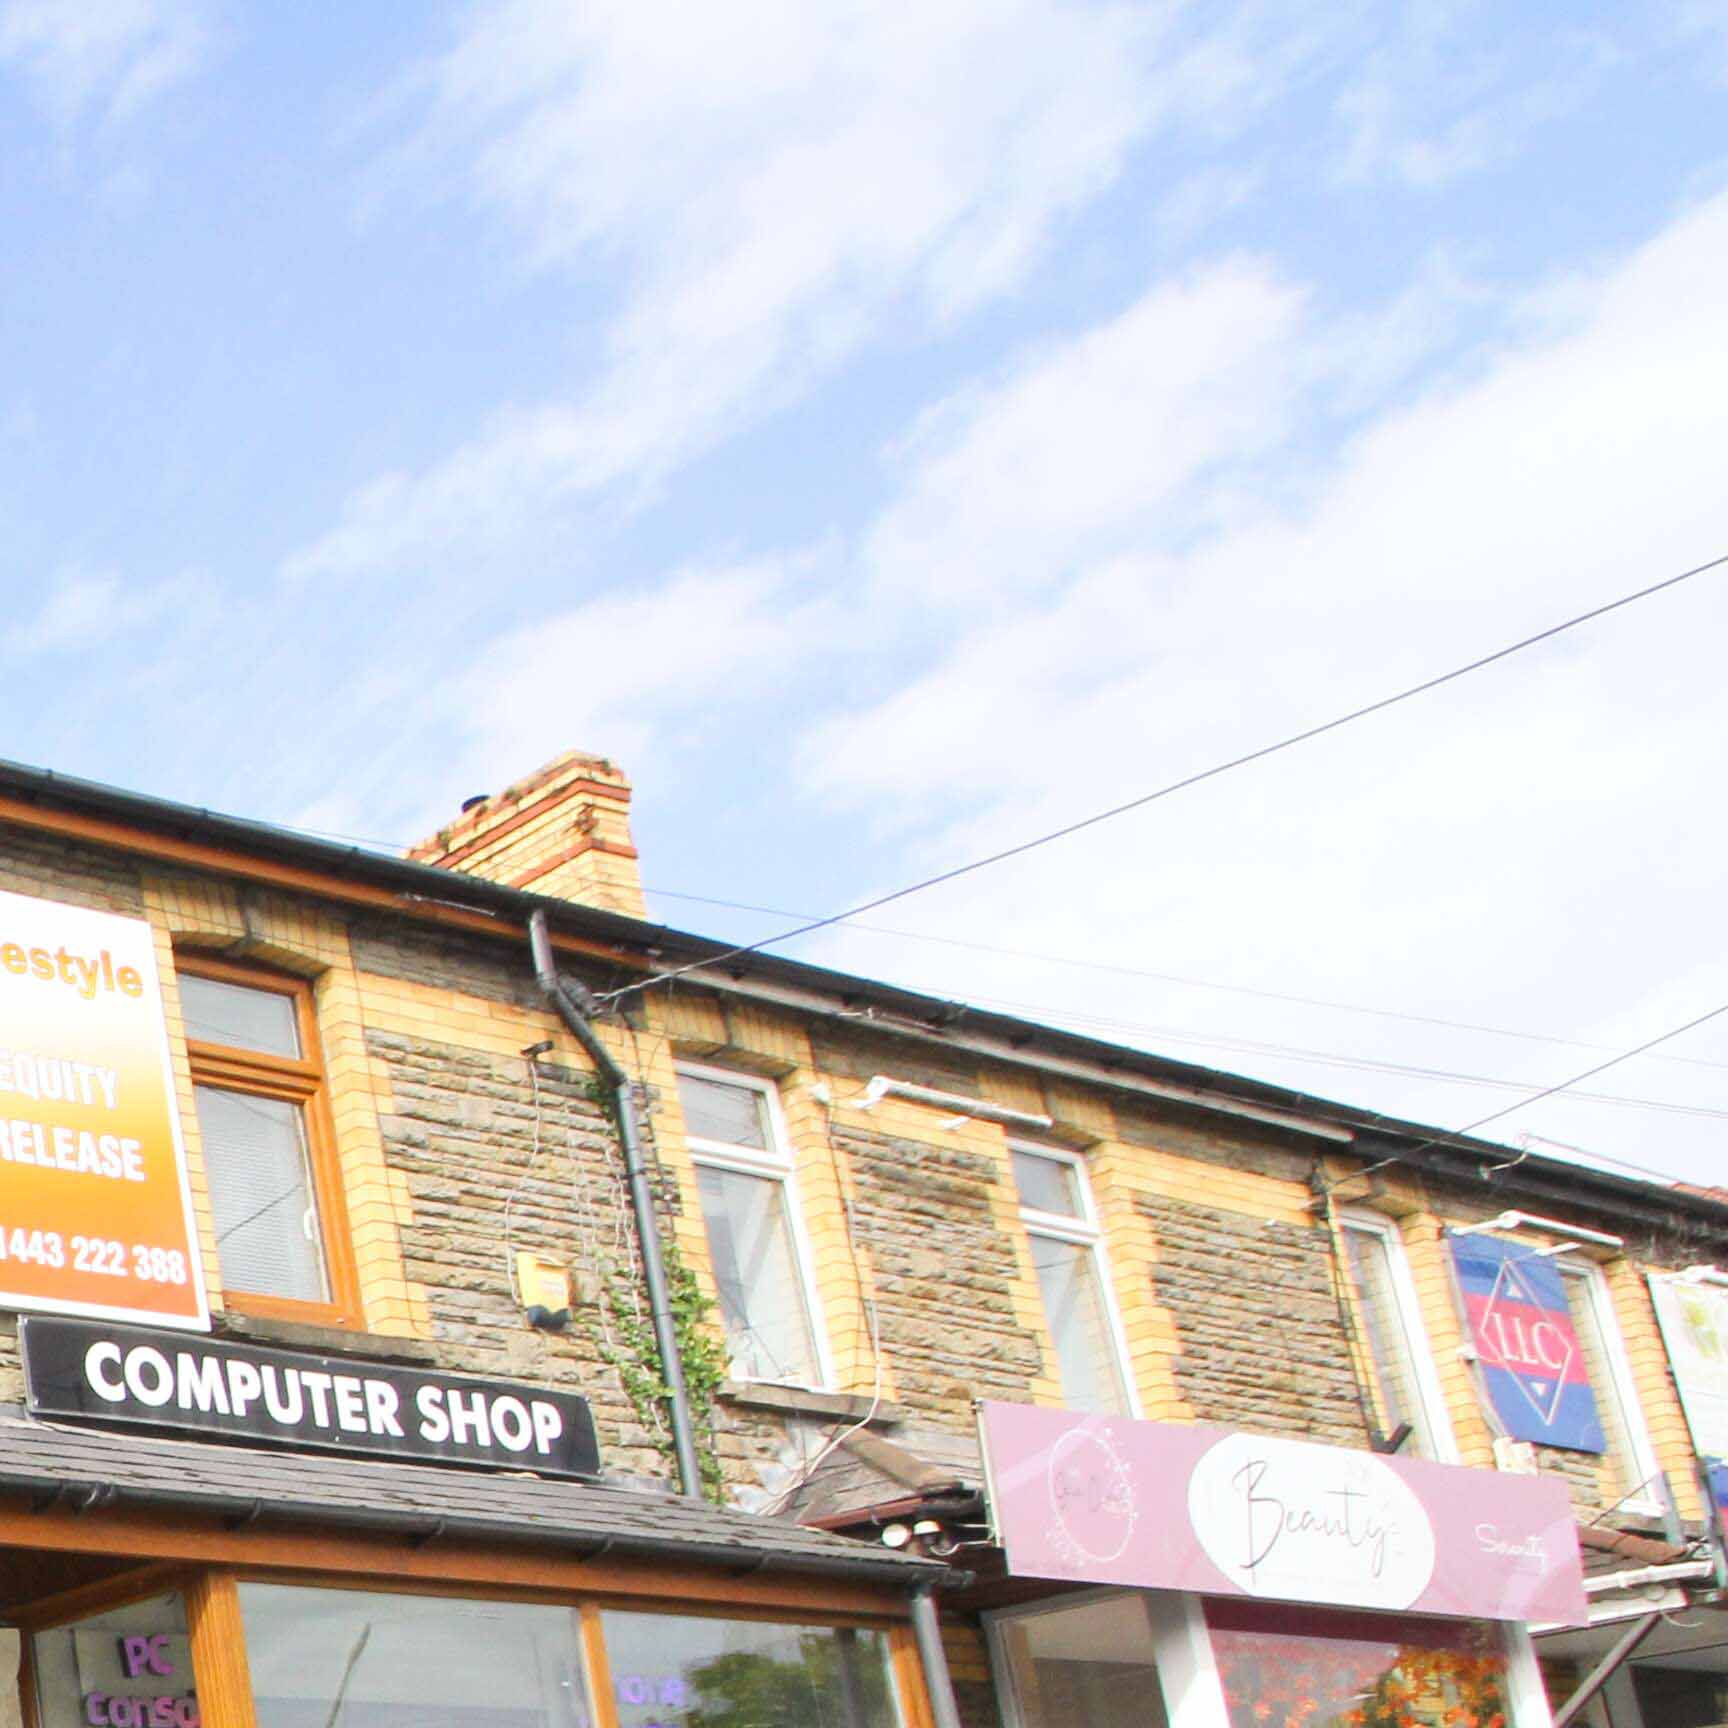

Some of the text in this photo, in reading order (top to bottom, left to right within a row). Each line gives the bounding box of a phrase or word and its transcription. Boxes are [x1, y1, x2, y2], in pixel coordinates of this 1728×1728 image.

[71, 1236, 129, 1277] 222
[132, 1244, 188, 1286] 388
[85, 1340, 563, 1455] COMPUTER SHOP
[1232, 1460, 1386, 1584] Beauty
[121, 1633, 176, 1678] PC
